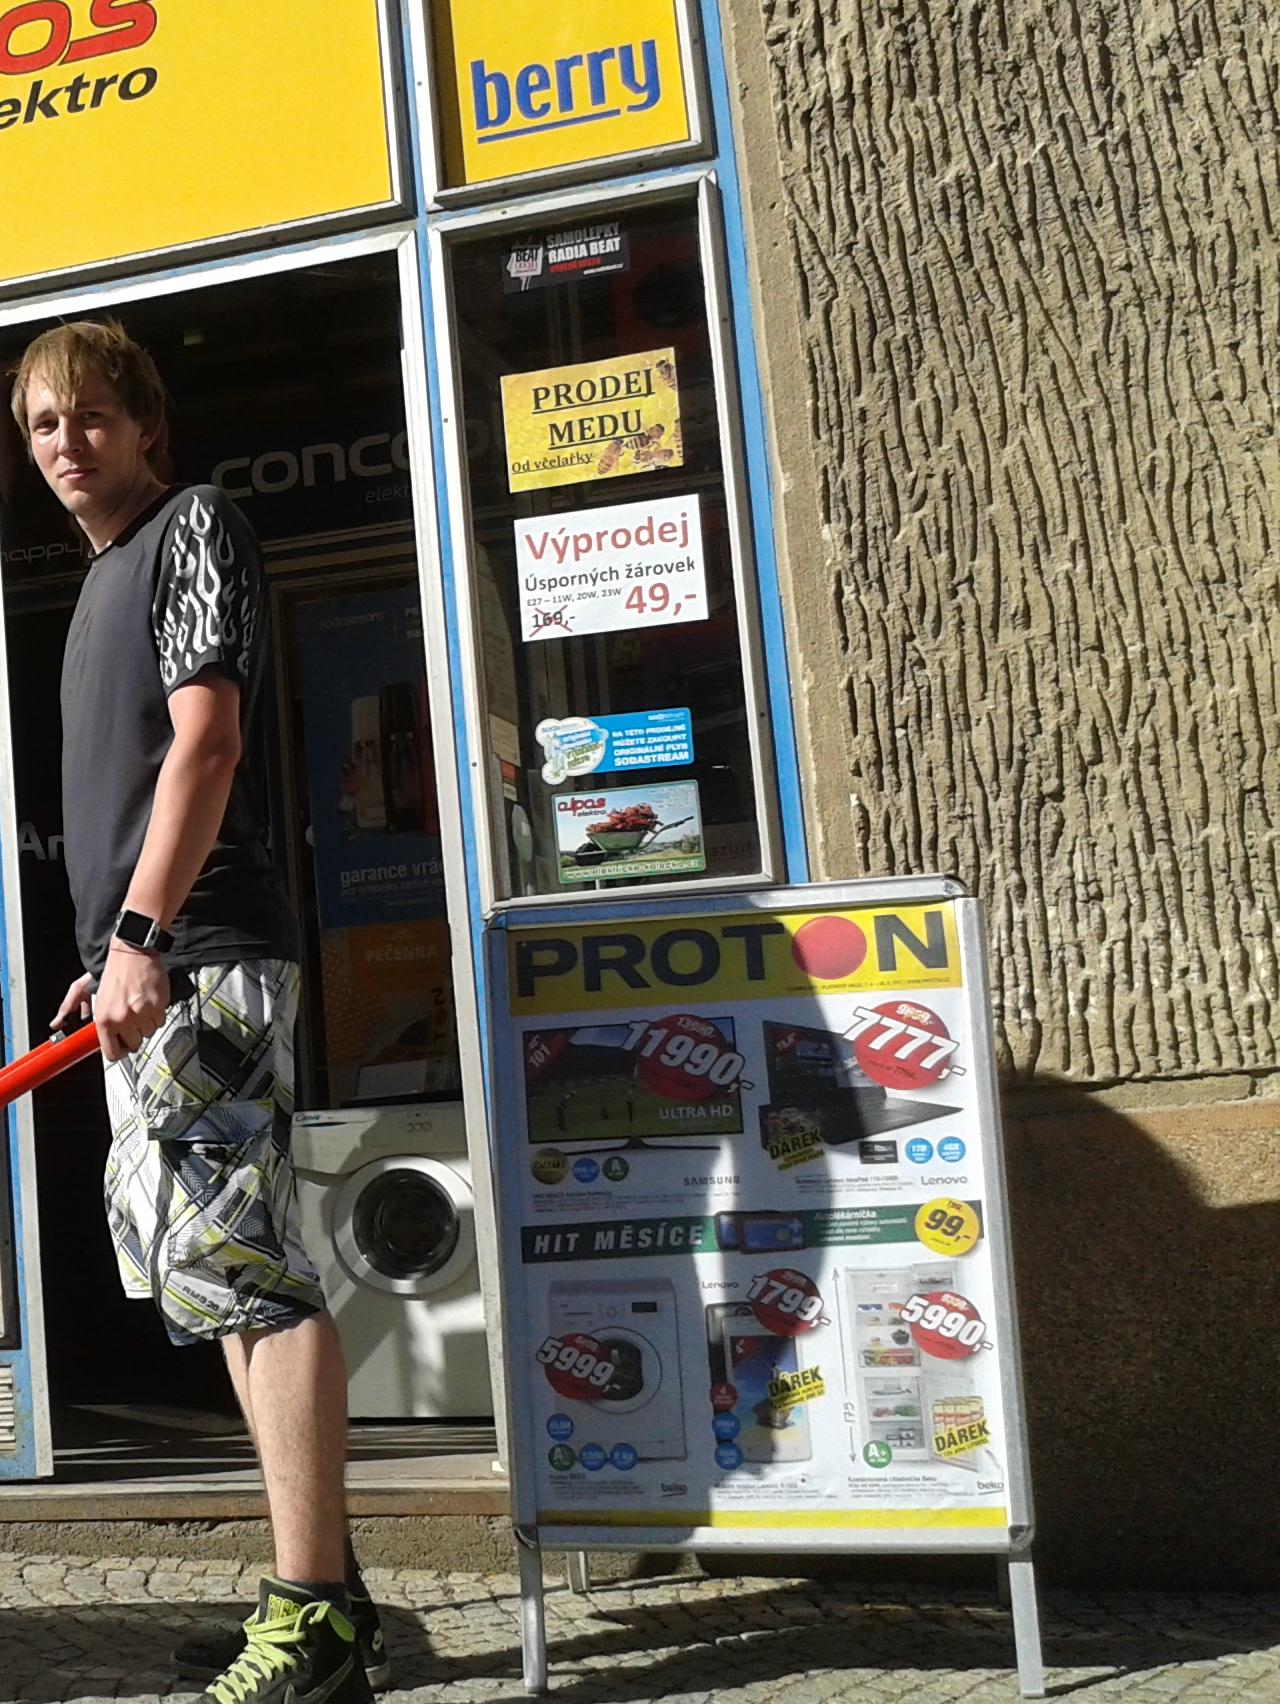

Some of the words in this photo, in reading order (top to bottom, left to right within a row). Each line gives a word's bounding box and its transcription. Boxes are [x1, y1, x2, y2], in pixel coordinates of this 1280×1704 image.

[470, 39, 661, 130] berry
[589, 236, 621, 256] BEAT
[531, 368, 656, 411] PRODEJ
[548, 409, 644, 446] MEDU
[512, 460, 531, 474] Od
[524, 511, 689, 564] Výprodej
[524, 565, 620, 593] Úsporných
[624, 556, 696, 580] žárovek
[624, 582, 697, 616] 49,-
[340, 862, 408, 888] garance
[515, 911, 949, 997] PROTON
[621, 1020, 756, 1093] 11990,-
[842, 1005, 967, 1081] 7777,-
[658, 1106, 712, 1121] ULTRA
[715, 1104, 734, 1118] HD
[920, 1174, 968, 1186] Lenovo
[532, 1232, 582, 1255] HIT
[593, 1222, 705, 1251] MĚSÍCE
[924, 1209, 971, 1243] 99,-
[744, 1274, 832, 1328] 1799,-
[899, 1293, 994, 1352] 5990,-
[534, 1337, 623, 1393] 5999,-
[768, 1366, 822, 1397] DÁREK
[934, 1419, 990, 1452] DÁREK
[977, 1481, 1004, 1492] beko
